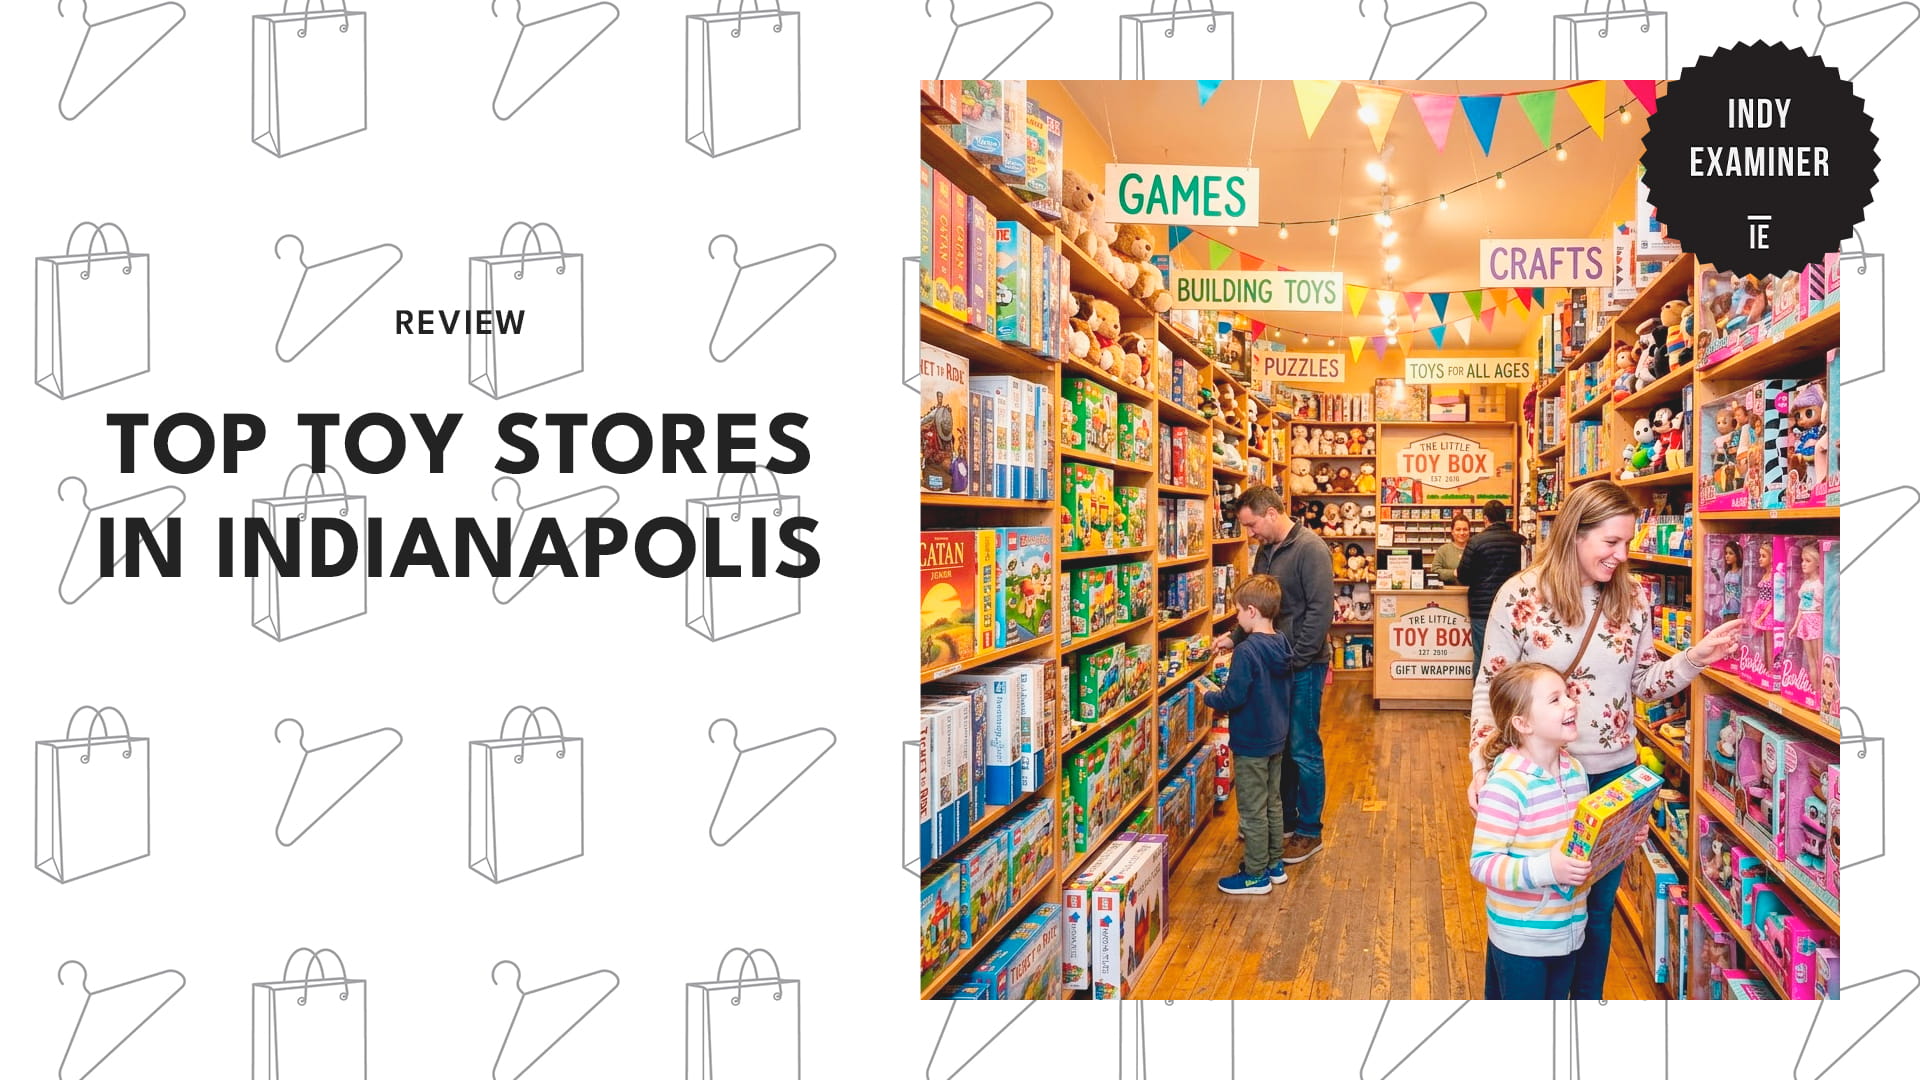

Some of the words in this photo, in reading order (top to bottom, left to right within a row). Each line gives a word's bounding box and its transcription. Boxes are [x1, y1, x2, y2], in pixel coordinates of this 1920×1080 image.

[1118, 173, 1246, 217] GAMES
[1490, 246, 1603, 280] CRAFTS
[1178, 278, 1273, 304] BUILDING
[1285, 279, 1336, 304] TOYS
[1264, 357, 1339, 378] PUZZLES
[1410, 363, 1445, 379] TOYS
[1448, 366, 1464, 376] FOR
[1466, 363, 1490, 379] ALL
[1494, 362, 1530, 379] AGES
[1420, 442, 1437, 452] THE
[1441, 441, 1471, 452] LITTLE
[1403, 454, 1440, 473] TOY
[1449, 454, 1488, 473] BOX
[920, 542, 964, 567] CATAN
[1429, 615, 1457, 625] LITTLE
[1393, 627, 1429, 647] TOY
[1436, 627, 1472, 647] BOX
[1395, 665, 1417, 675] GIFT
[1421, 665, 1471, 676] WRAPPING
